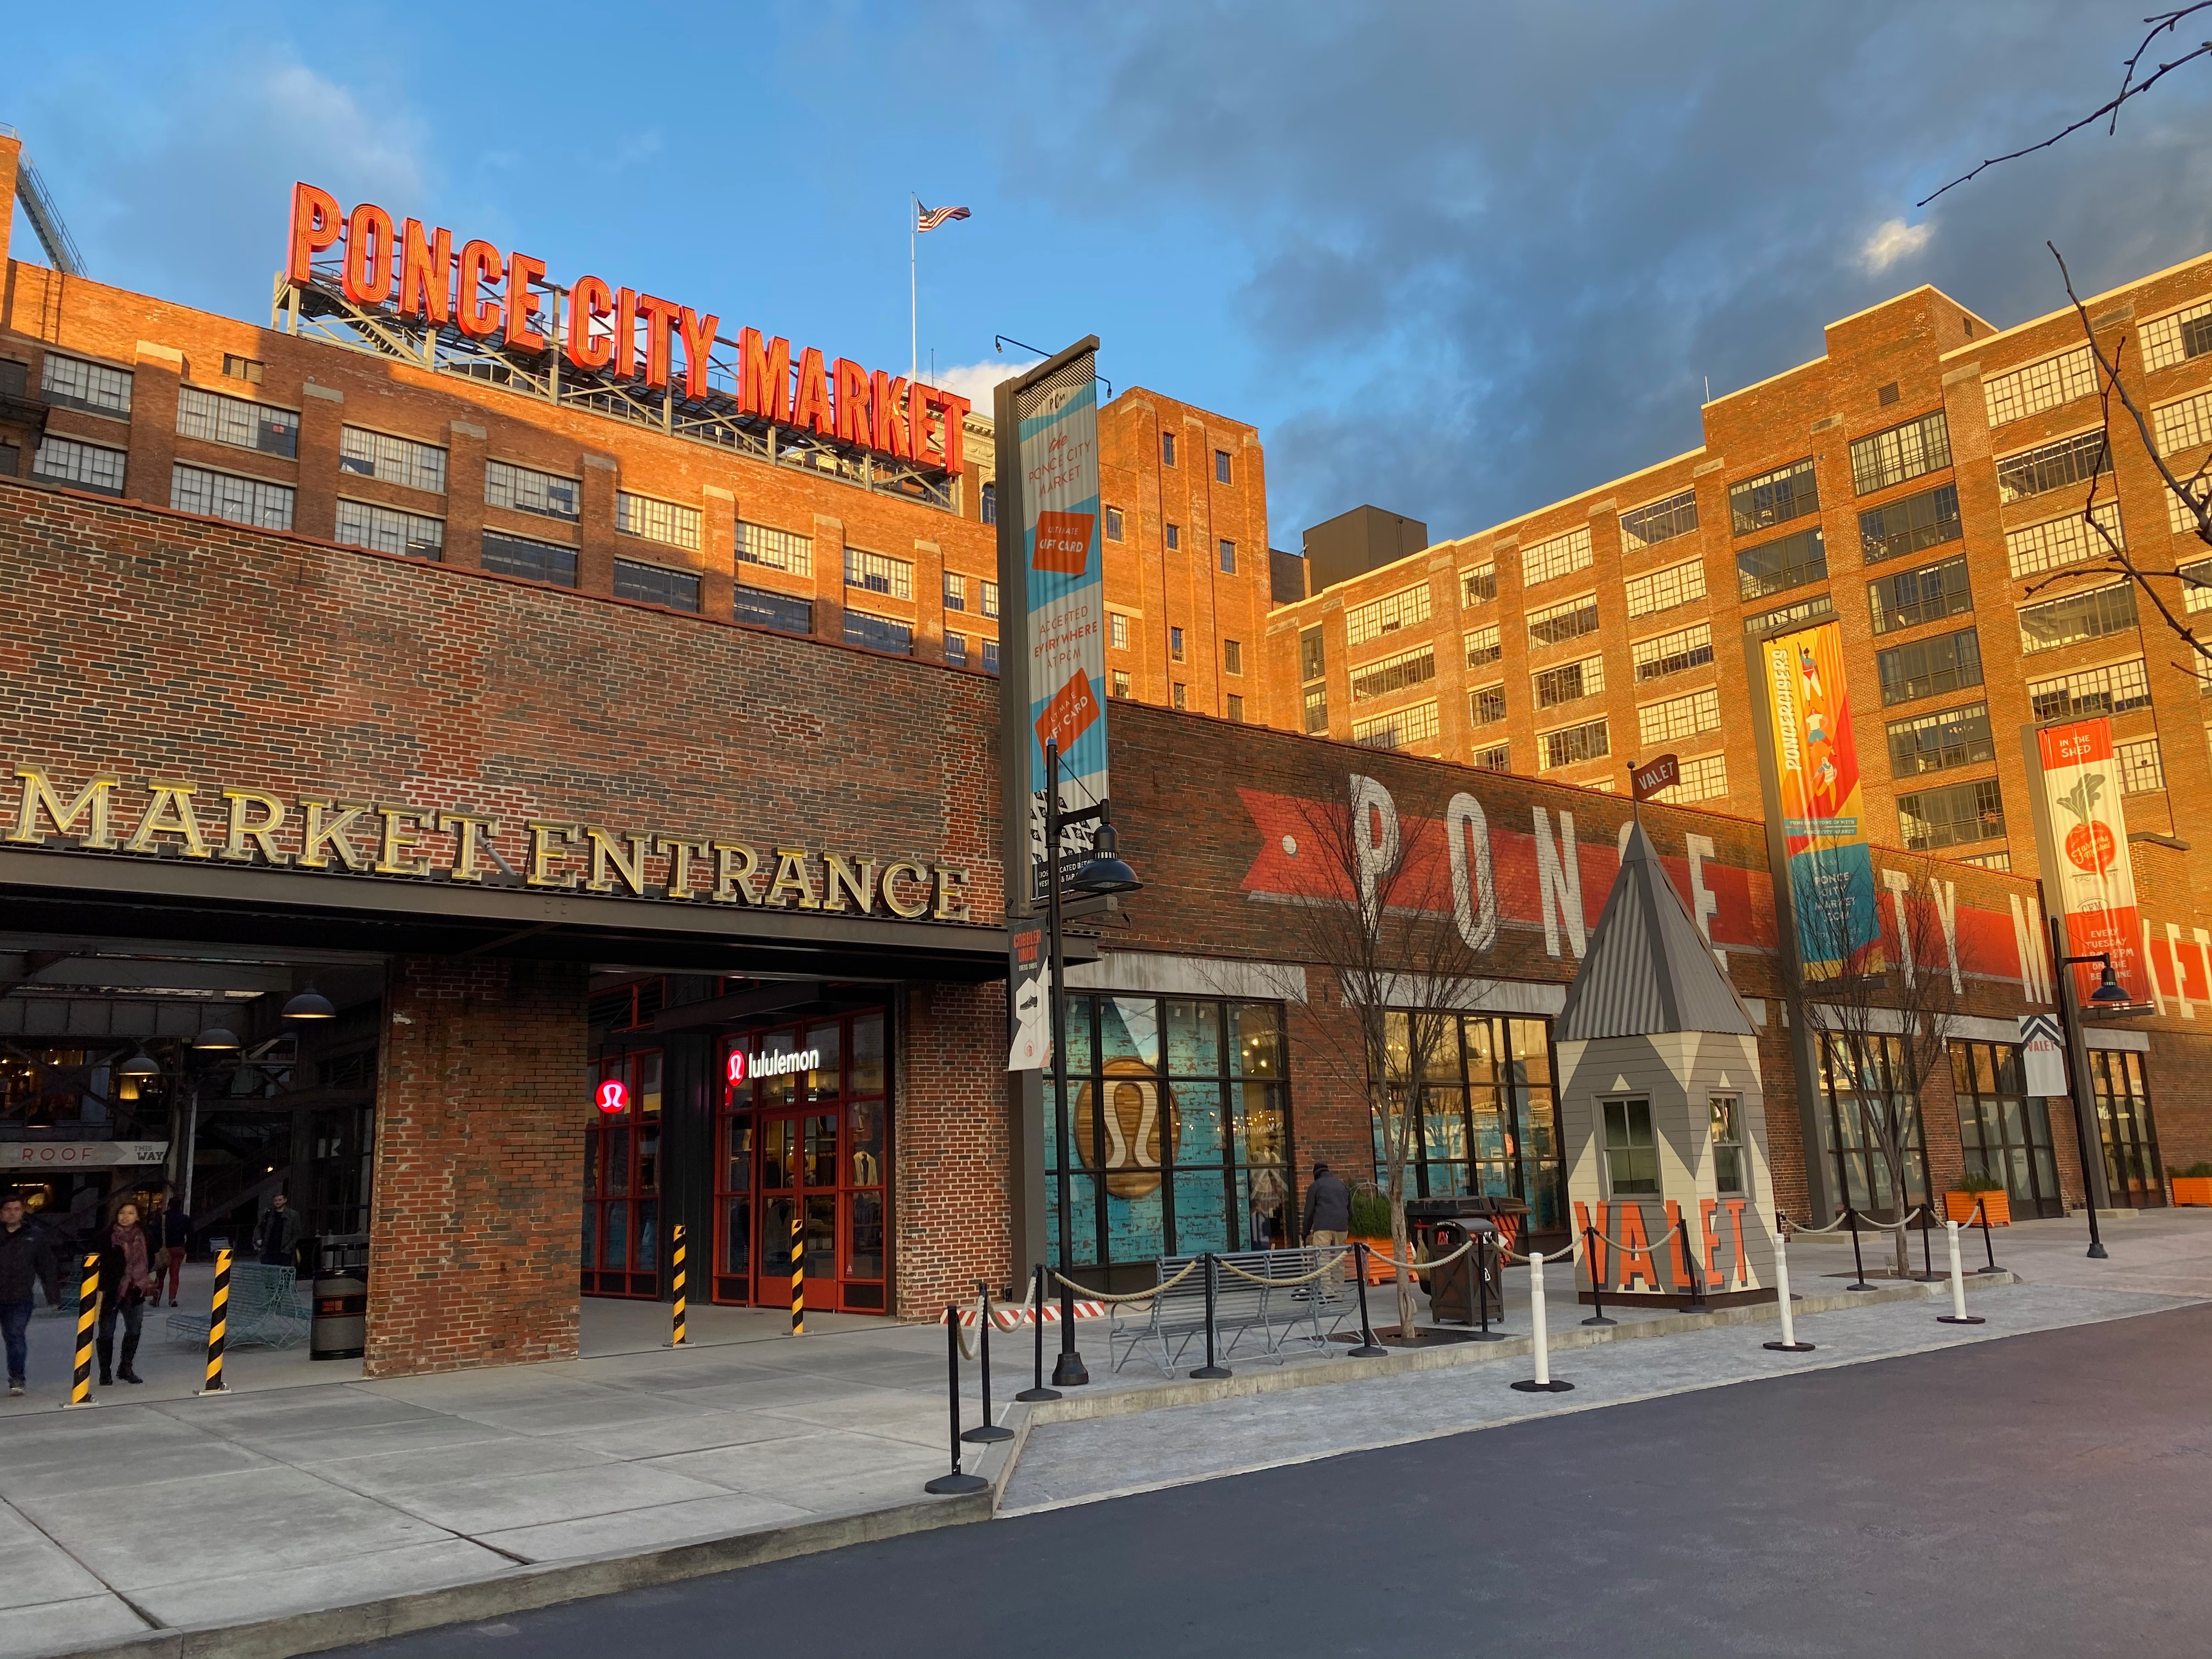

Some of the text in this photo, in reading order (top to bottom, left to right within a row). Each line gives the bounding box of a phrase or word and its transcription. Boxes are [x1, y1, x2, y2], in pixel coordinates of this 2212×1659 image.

[285, 180, 972, 476] PONCE CITY MARKET
[1049, 431, 1068, 453] the
[1029, 439, 1091, 484] PONCE CITY
[1039, 465, 1081, 498] MARKET
[1040, 539, 1084, 552] GIFT CARD
[1040, 606, 1088, 636] ACCEPTED
[1035, 621, 1097, 658] EVERYWHERE
[1047, 647, 1081, 668] AT PCM
[1048, 691, 1077, 726] ULTIMAE
[1063, 696, 1088, 725] CARD
[2059, 734, 2091, 747] IN THE
[2061, 744, 2091, 758] SHED
[1638, 761, 1673, 790] VALET
[4, 763, 970, 922] MARKET ENTRANCE
[1065, 873, 1075, 882] TAP
[1349, 773, 1729, 972] PONE
[1013, 929, 1041, 949] COBBLER
[2085, 937, 2127, 949] TUESDAY
[2091, 928, 2118, 938] EVERY
[1018, 944, 1037, 962] UNION
[2092, 962, 2105, 970] ON
[2027, 1040, 2055, 1052] VALET
[748, 1048, 820, 1079] lululemon
[21, 1148, 94, 1161] ROOF
[137, 1152, 165, 1161] WAY
[1573, 1199, 1746, 1287] VALET
